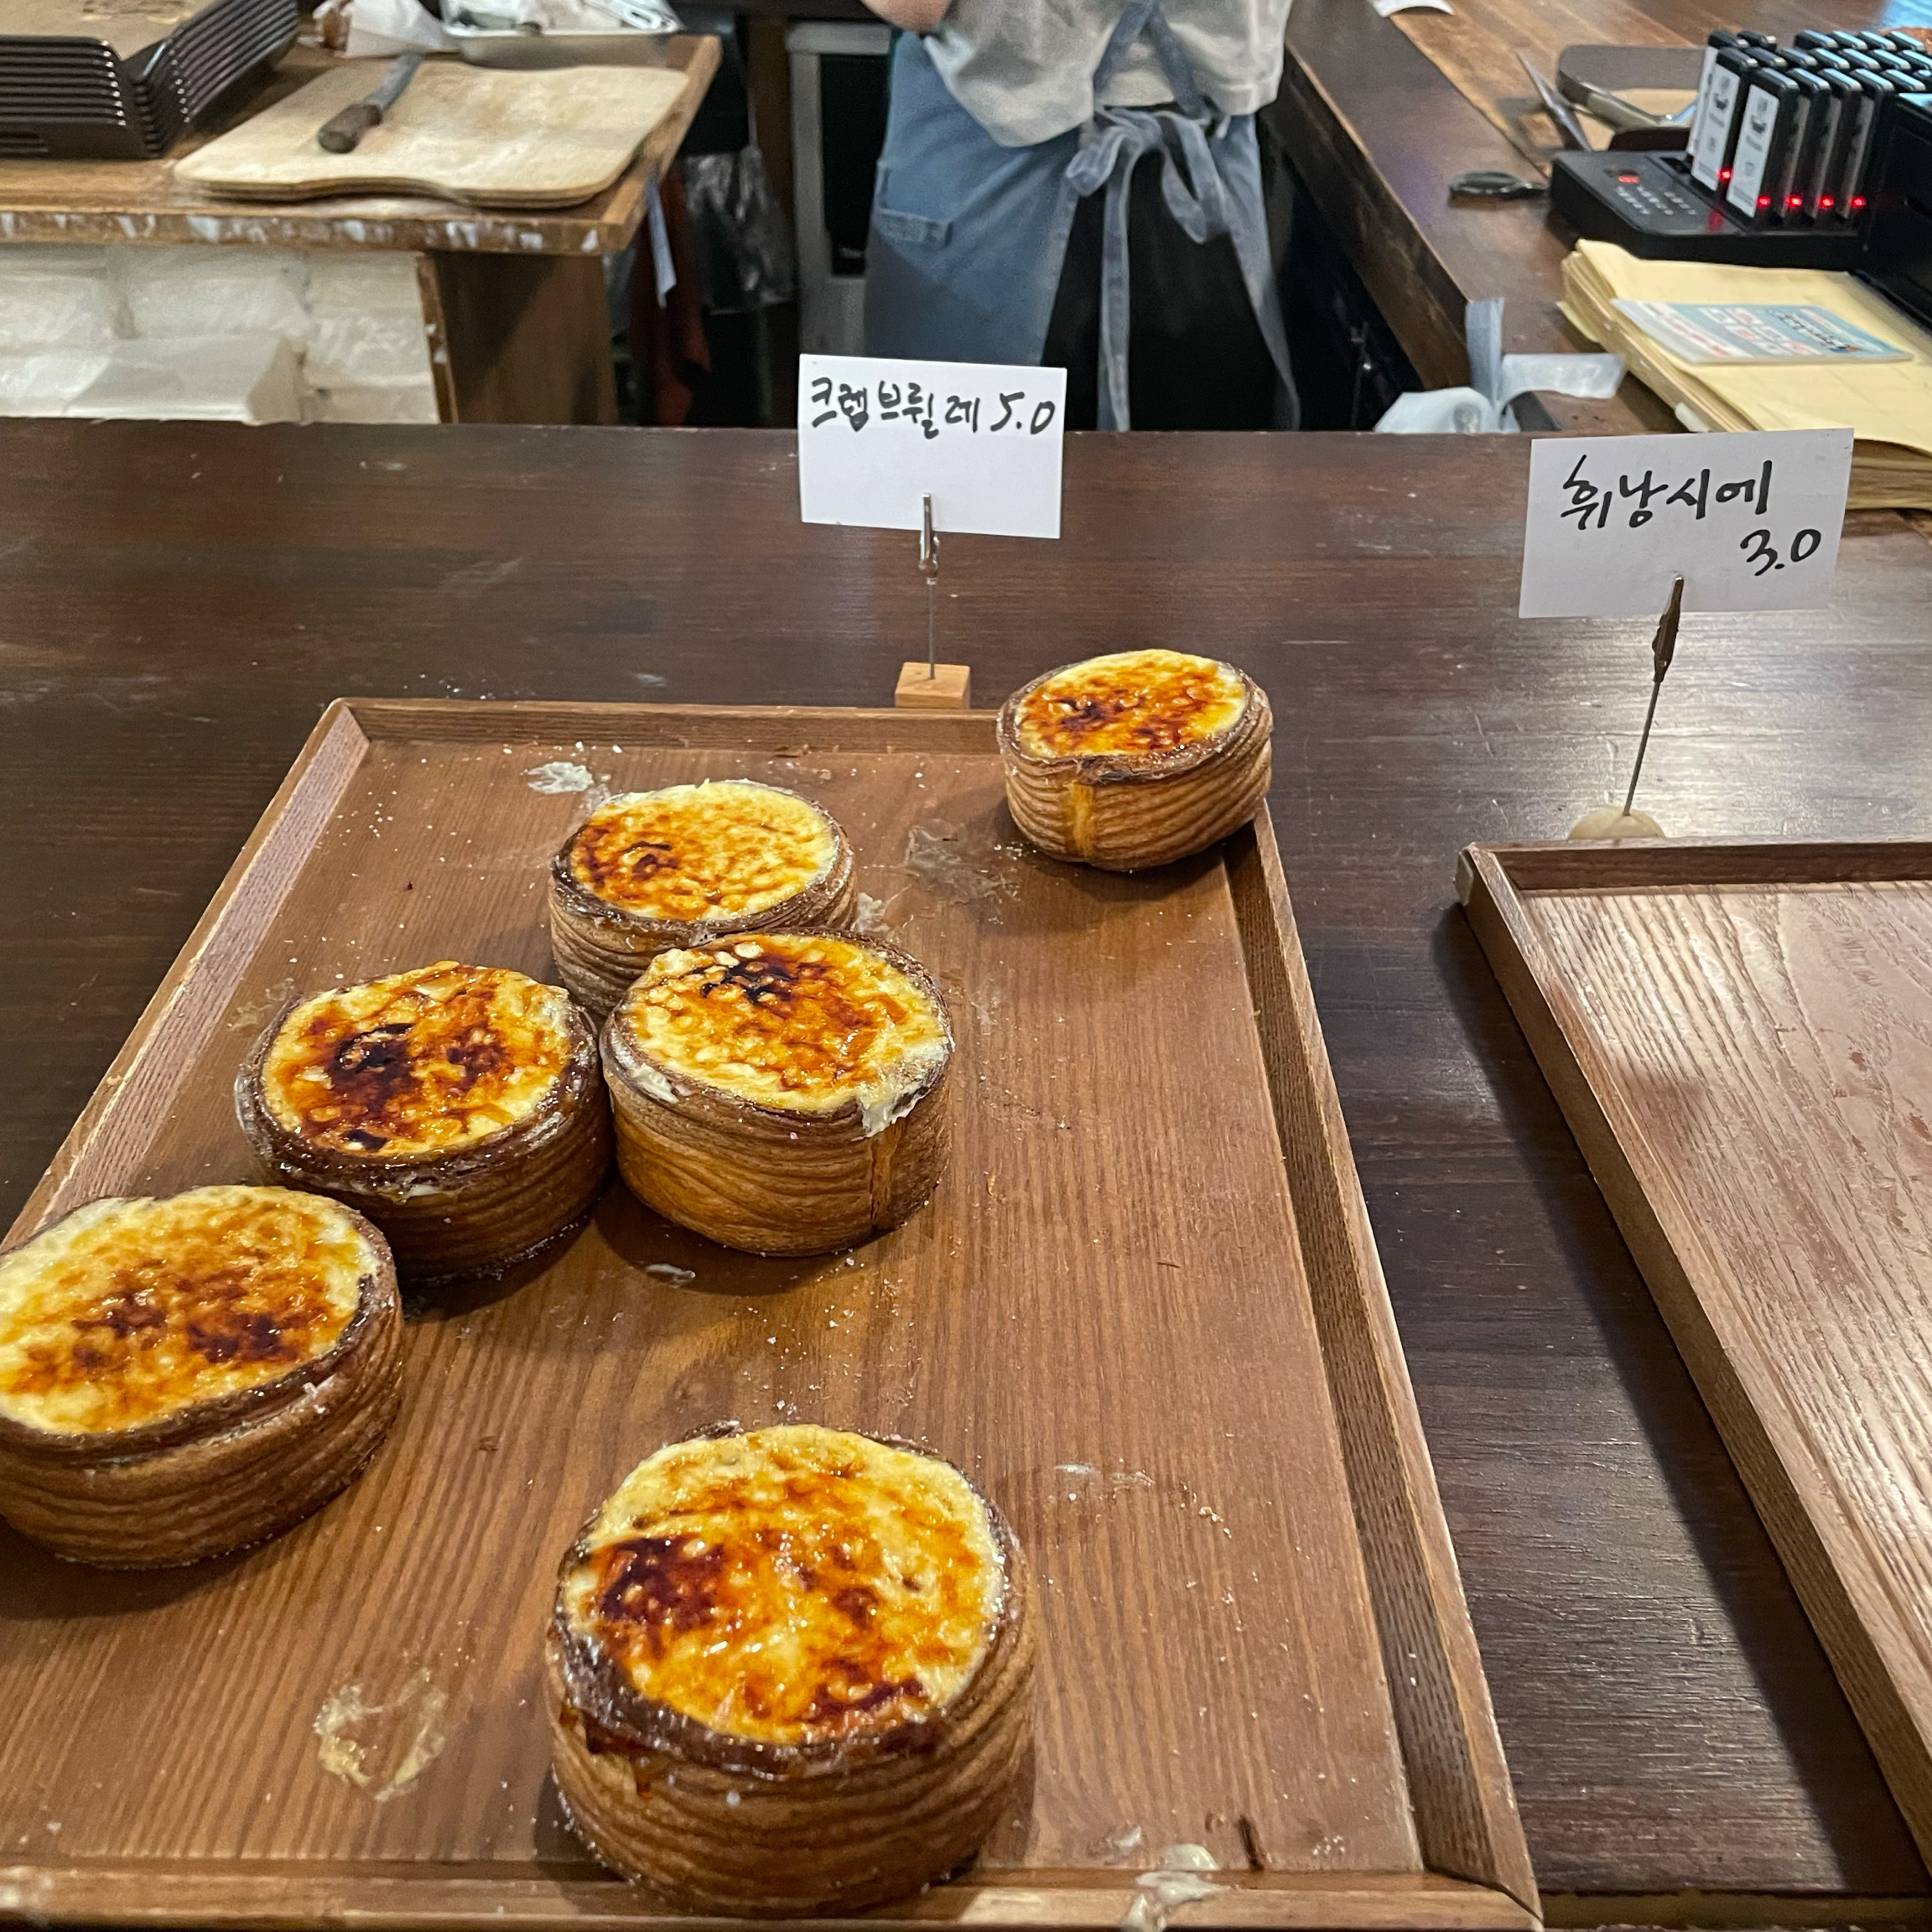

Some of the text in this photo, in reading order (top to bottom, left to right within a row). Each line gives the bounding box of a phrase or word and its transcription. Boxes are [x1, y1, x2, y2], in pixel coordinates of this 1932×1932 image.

[989, 392, 1056, 435] 5.0
[1560, 454, 1773, 537] 휘낭시에
[1739, 528, 1822, 577] 3.0
